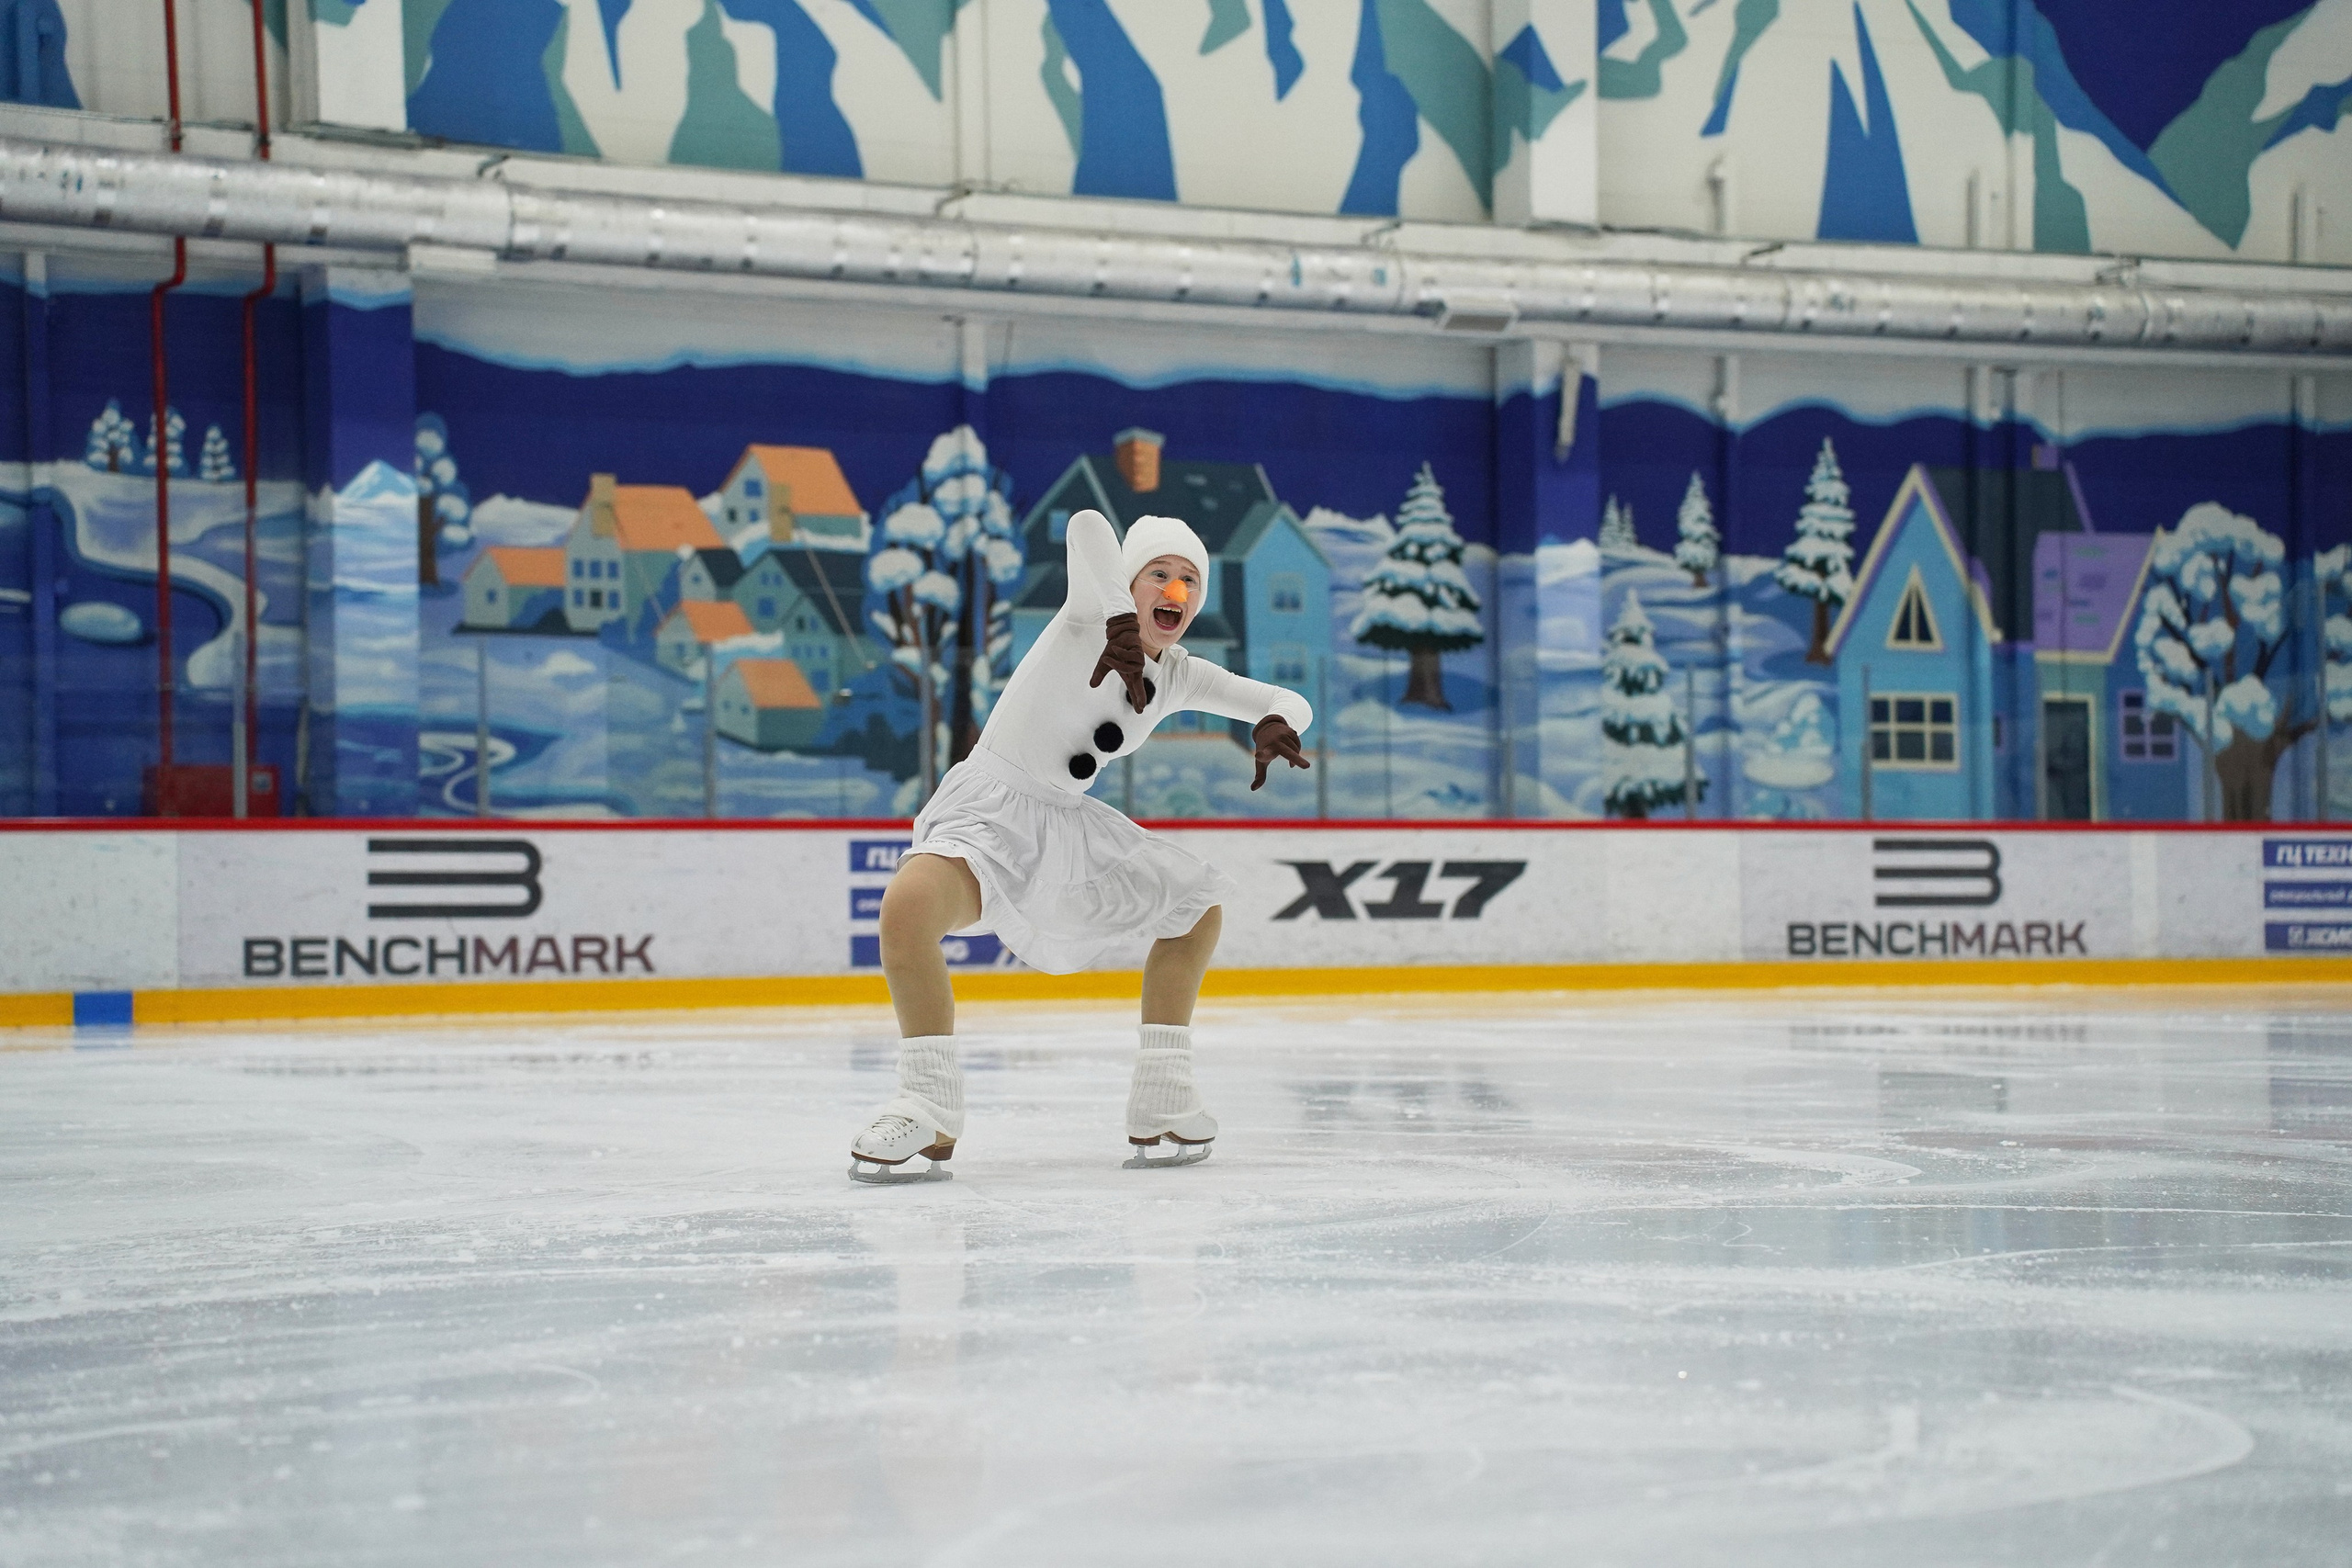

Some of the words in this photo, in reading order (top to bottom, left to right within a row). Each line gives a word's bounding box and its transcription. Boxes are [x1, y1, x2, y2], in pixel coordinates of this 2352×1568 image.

[1271, 858, 1528, 921] X17
[243, 933, 656, 978] BENCHMARK
[1788, 920, 2087, 956] BENCHMARK
